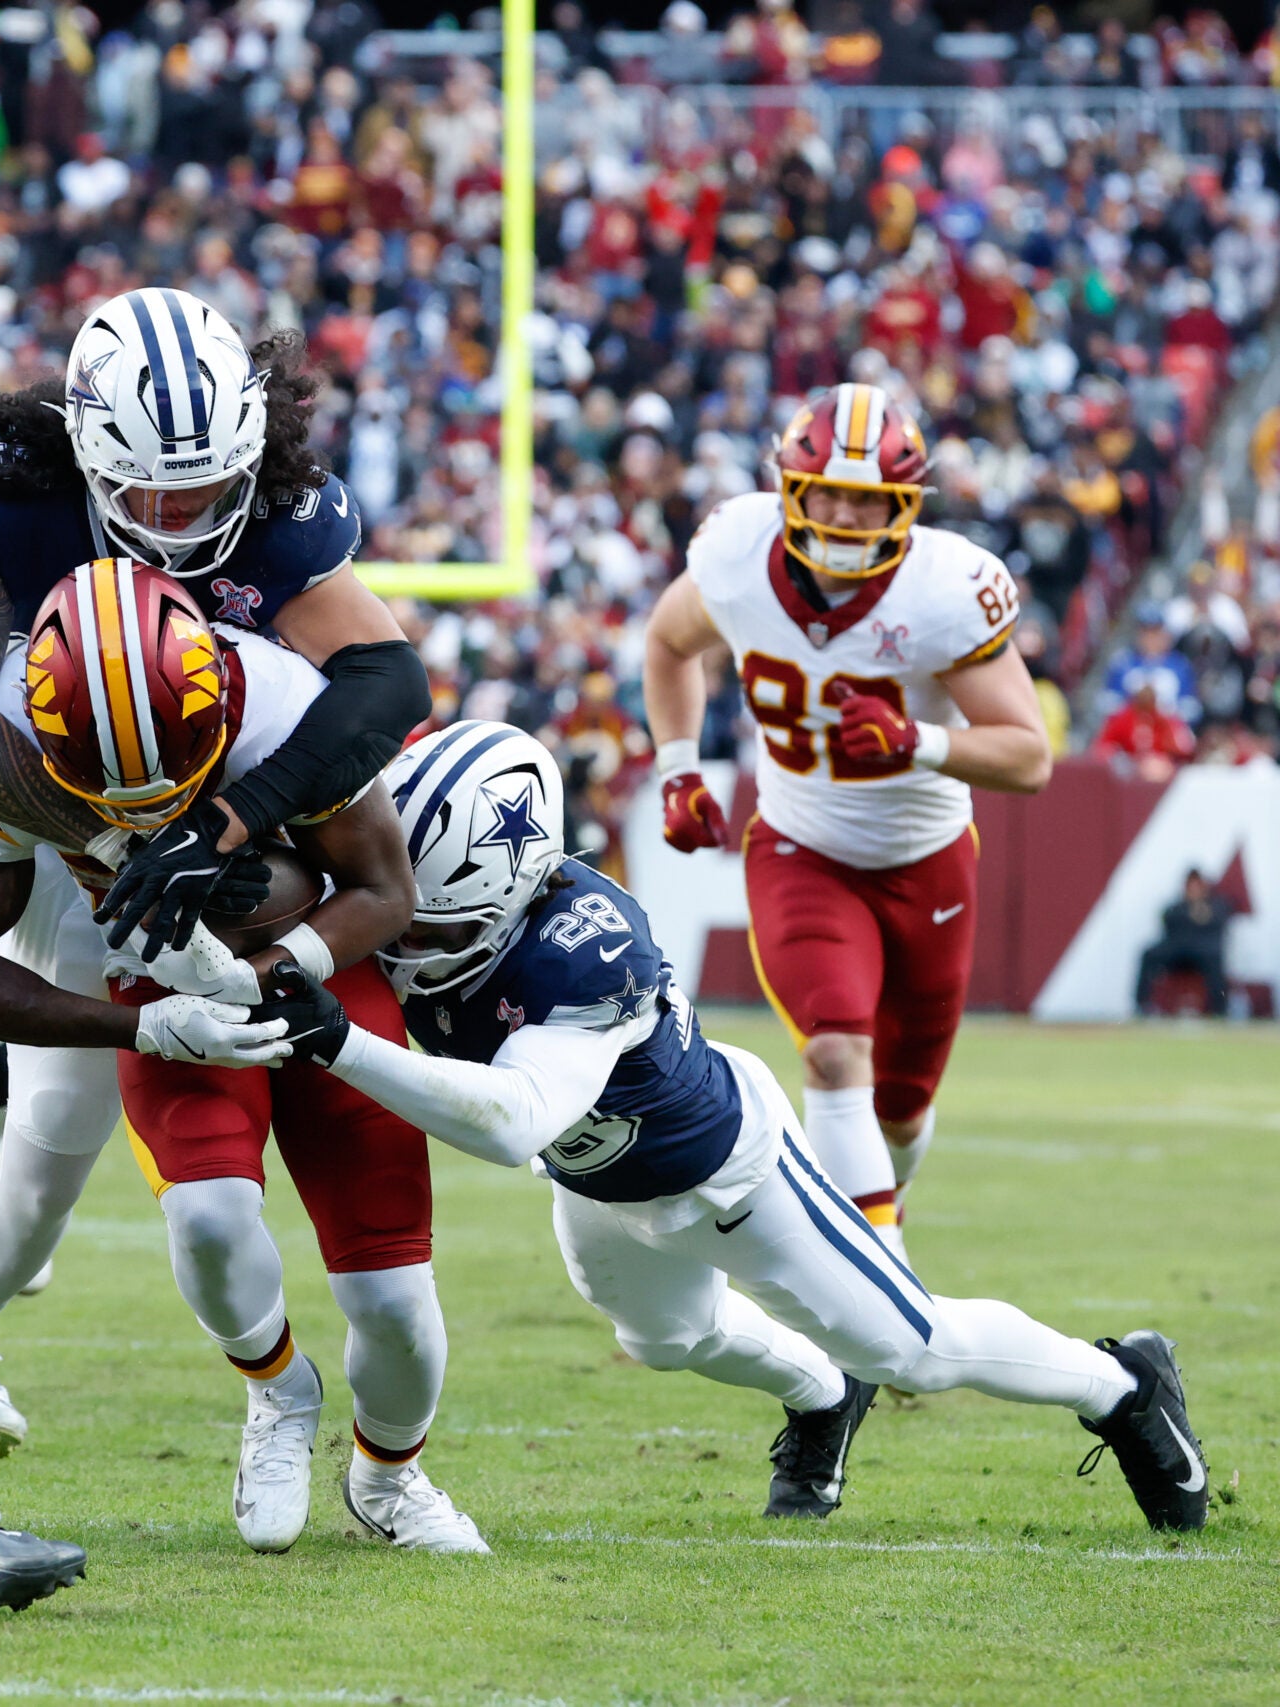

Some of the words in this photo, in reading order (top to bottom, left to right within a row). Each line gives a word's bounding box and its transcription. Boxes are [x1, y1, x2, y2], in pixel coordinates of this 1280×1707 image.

[165, 456, 212, 470] COWBOYS
[228, 599, 247, 614] NFL
[977, 572, 1013, 627] 82
[740, 650, 914, 782] 82
[539, 893, 631, 953] 28
